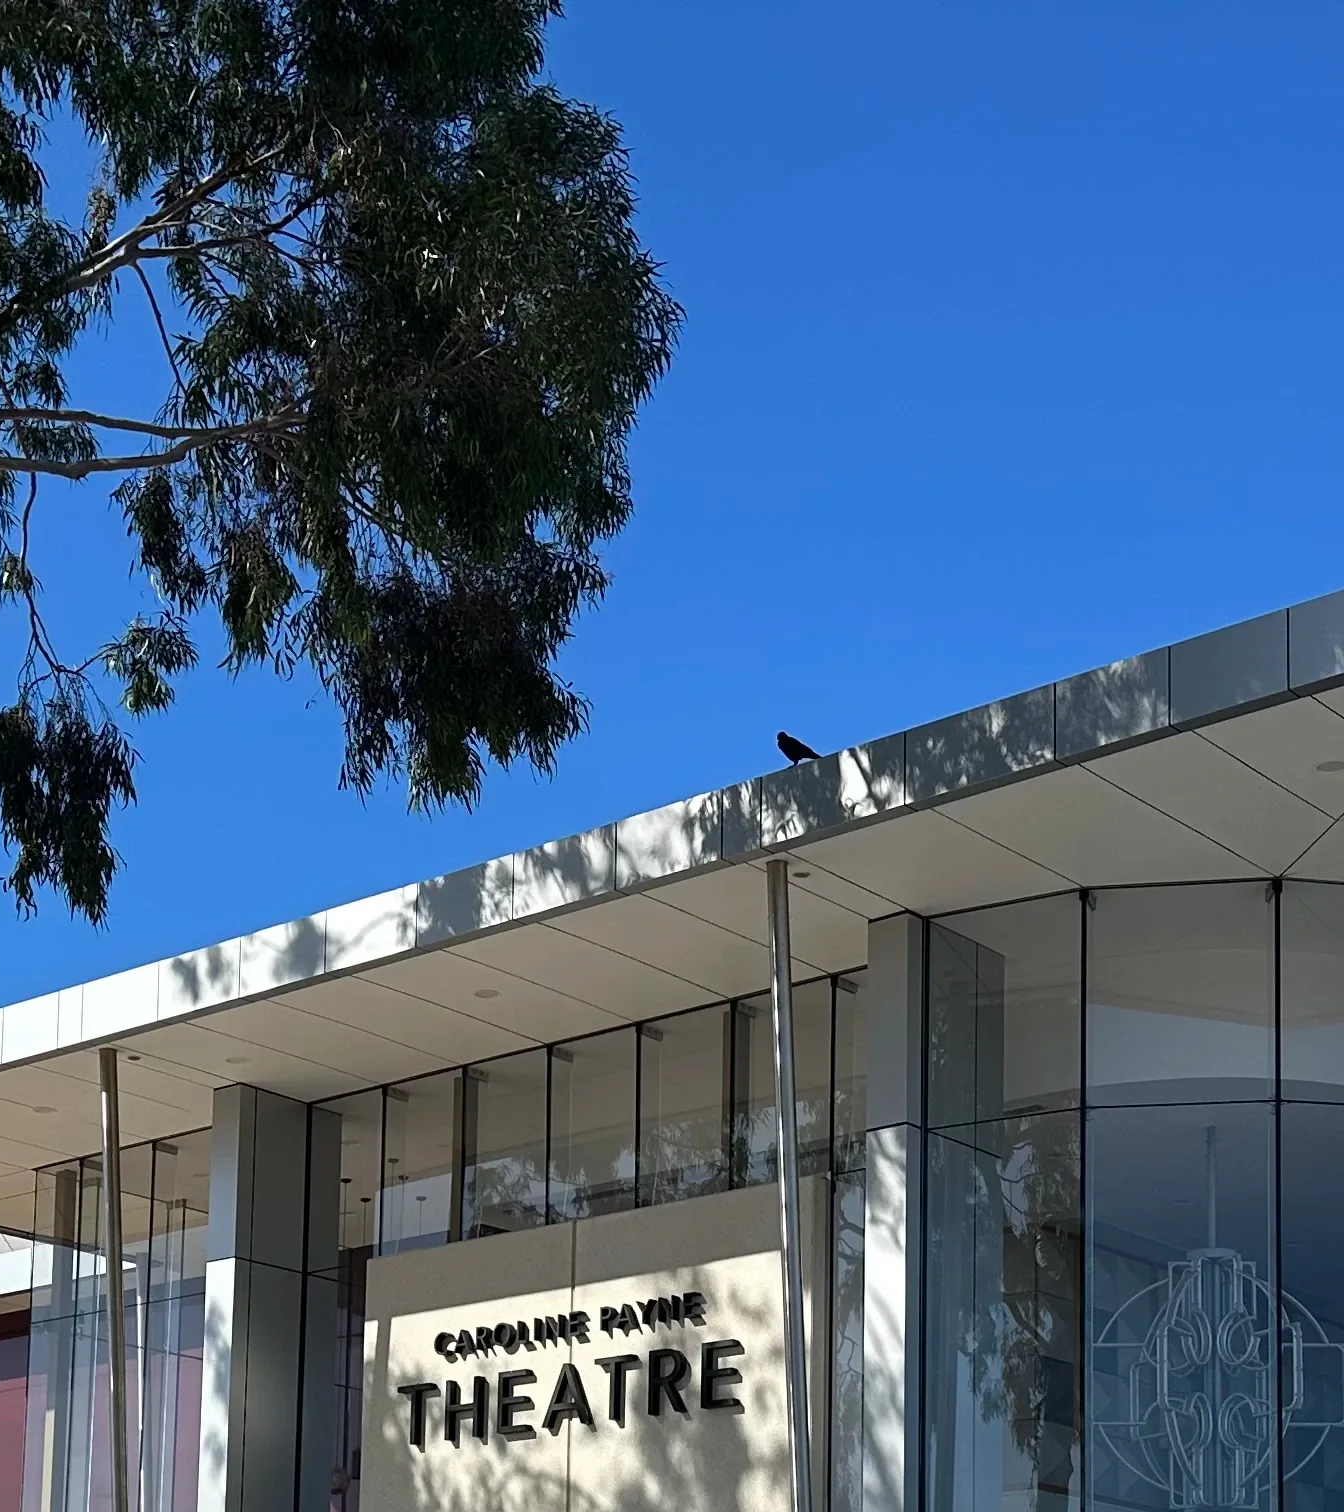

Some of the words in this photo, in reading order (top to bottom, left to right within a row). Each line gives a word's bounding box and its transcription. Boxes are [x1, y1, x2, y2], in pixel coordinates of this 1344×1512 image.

[434, 1311, 591, 1363] CAROLINE
[600, 1292, 707, 1339] PAYNE
[397, 1339, 745, 1452] THEATRE
